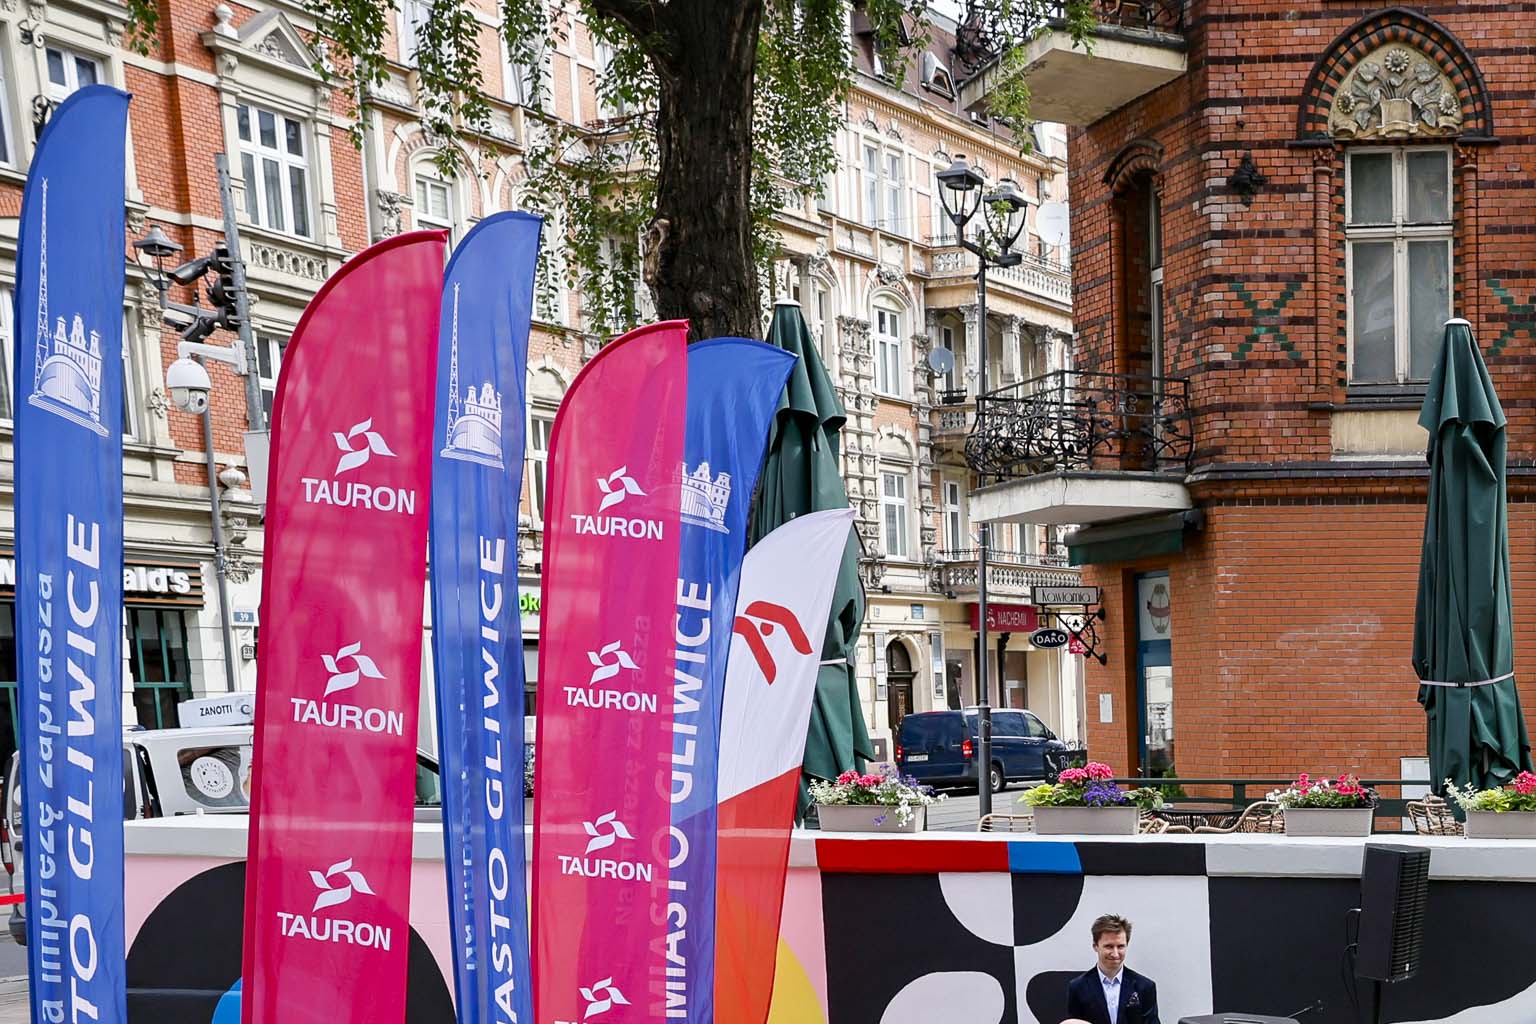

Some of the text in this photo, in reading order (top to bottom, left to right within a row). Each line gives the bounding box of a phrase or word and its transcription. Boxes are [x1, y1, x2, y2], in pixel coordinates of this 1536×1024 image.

[301, 477, 415, 515] TAURON
[570, 514, 664, 541] TAURON
[240, 611, 249, 622] 39
[38, 573, 61, 788] zaprasza
[67, 513, 100, 880] GLIWICE
[479, 535, 505, 820] GLIWICE
[200, 704, 233, 717] ZANOTTI
[290, 697, 404, 736] TAURON
[562, 686, 657, 713] TAURON
[648, 578, 712, 1018] MIASTO GLIWICE
[557, 855, 652, 882] TAURON
[276, 911, 391, 951] TAURON
